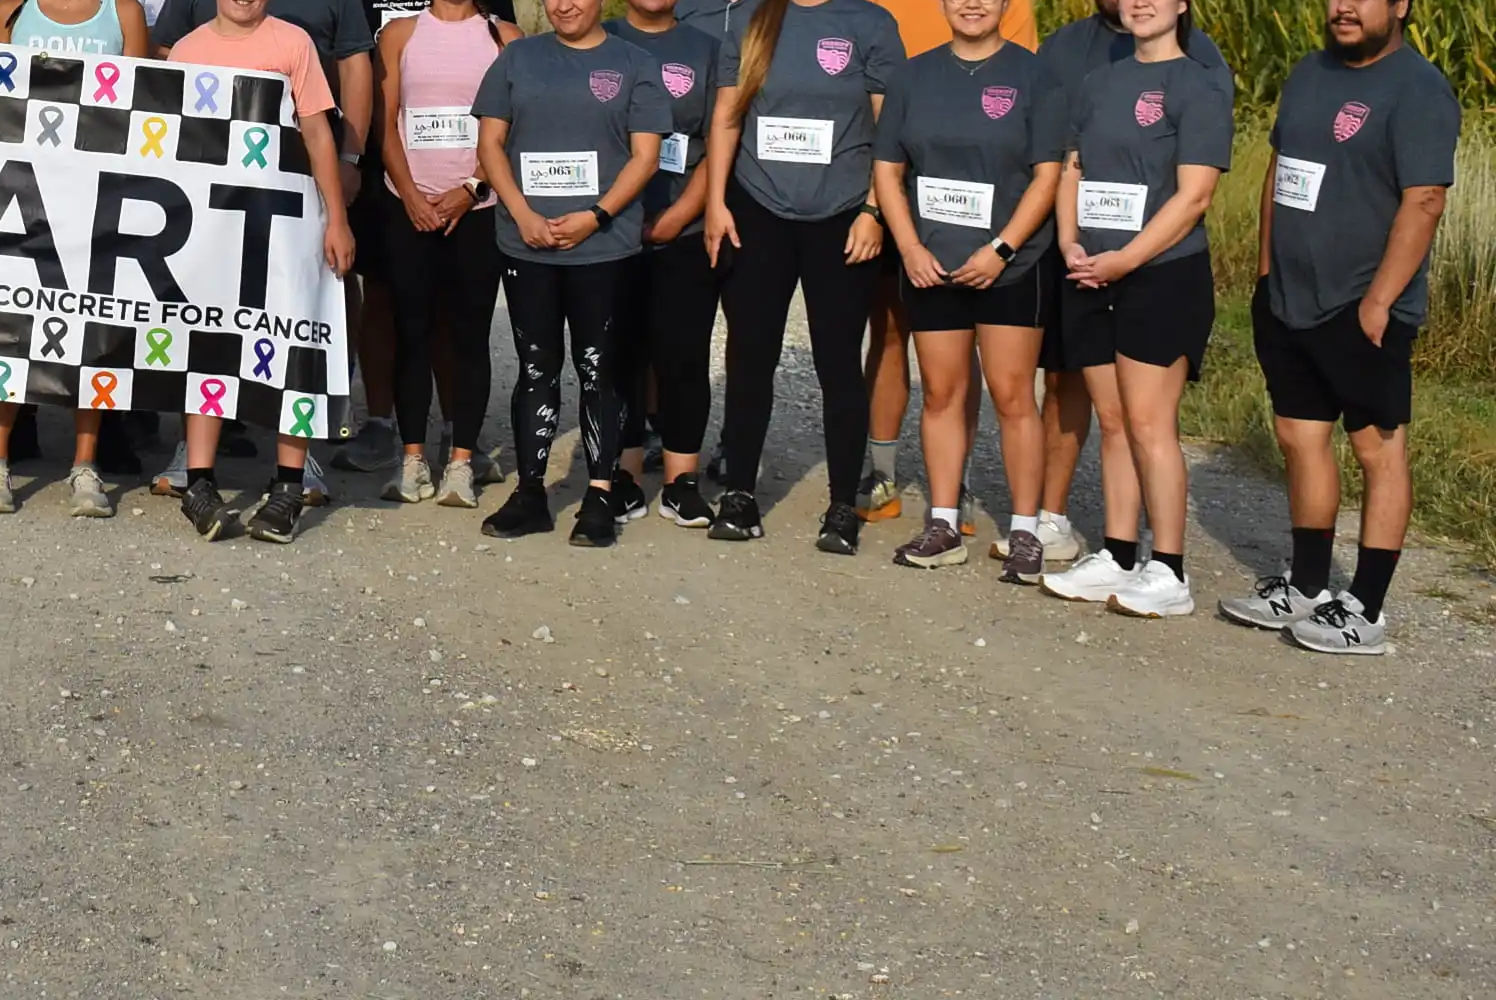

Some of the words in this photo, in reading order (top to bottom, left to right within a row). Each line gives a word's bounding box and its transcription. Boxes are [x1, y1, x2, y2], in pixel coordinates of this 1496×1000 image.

[783, 131, 807, 142] 066
[548, 166, 572, 176] 065
[943, 193, 967, 205] 060
[161, 303, 223, 328] FOR
[233, 308, 333, 346] CANCER
[1268, 597, 1293, 617] N
[1341, 627, 1361, 648] N
